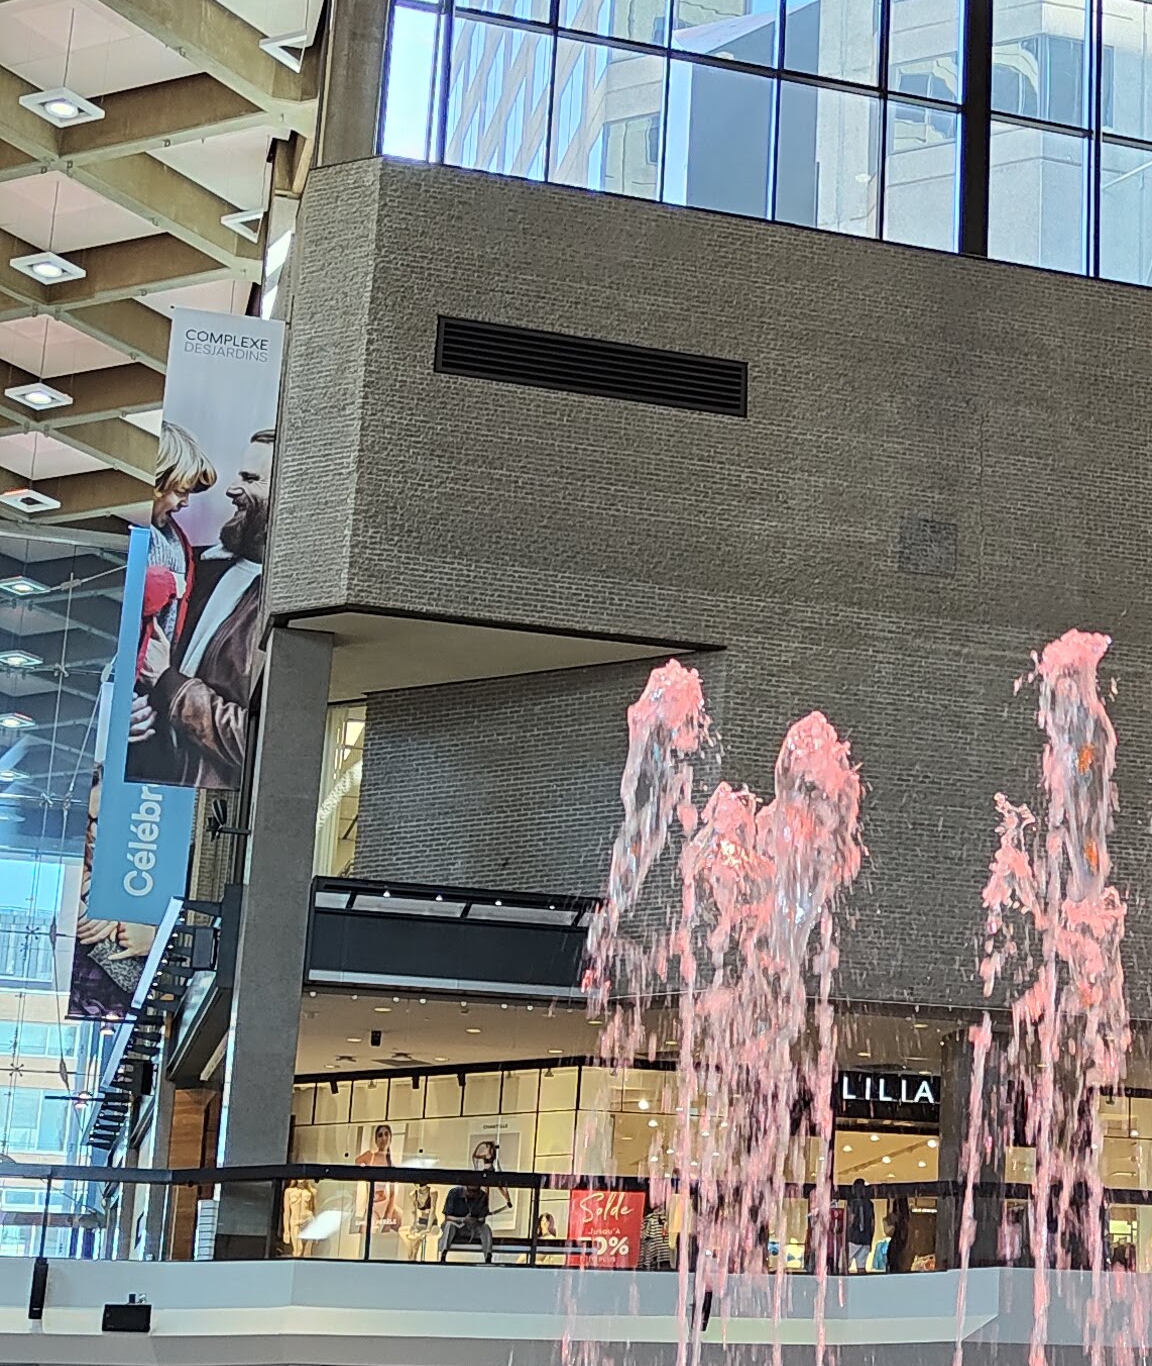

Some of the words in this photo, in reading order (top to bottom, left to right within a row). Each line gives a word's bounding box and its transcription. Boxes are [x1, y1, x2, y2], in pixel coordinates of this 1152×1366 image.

[184, 341, 268, 362] DESJARDINS
[185, 329, 269, 351] COMPLEXE
[123, 784, 163, 896] Célébr
[842, 1076, 935, 1103] LILIA
[580, 1192, 634, 1224] Solde
